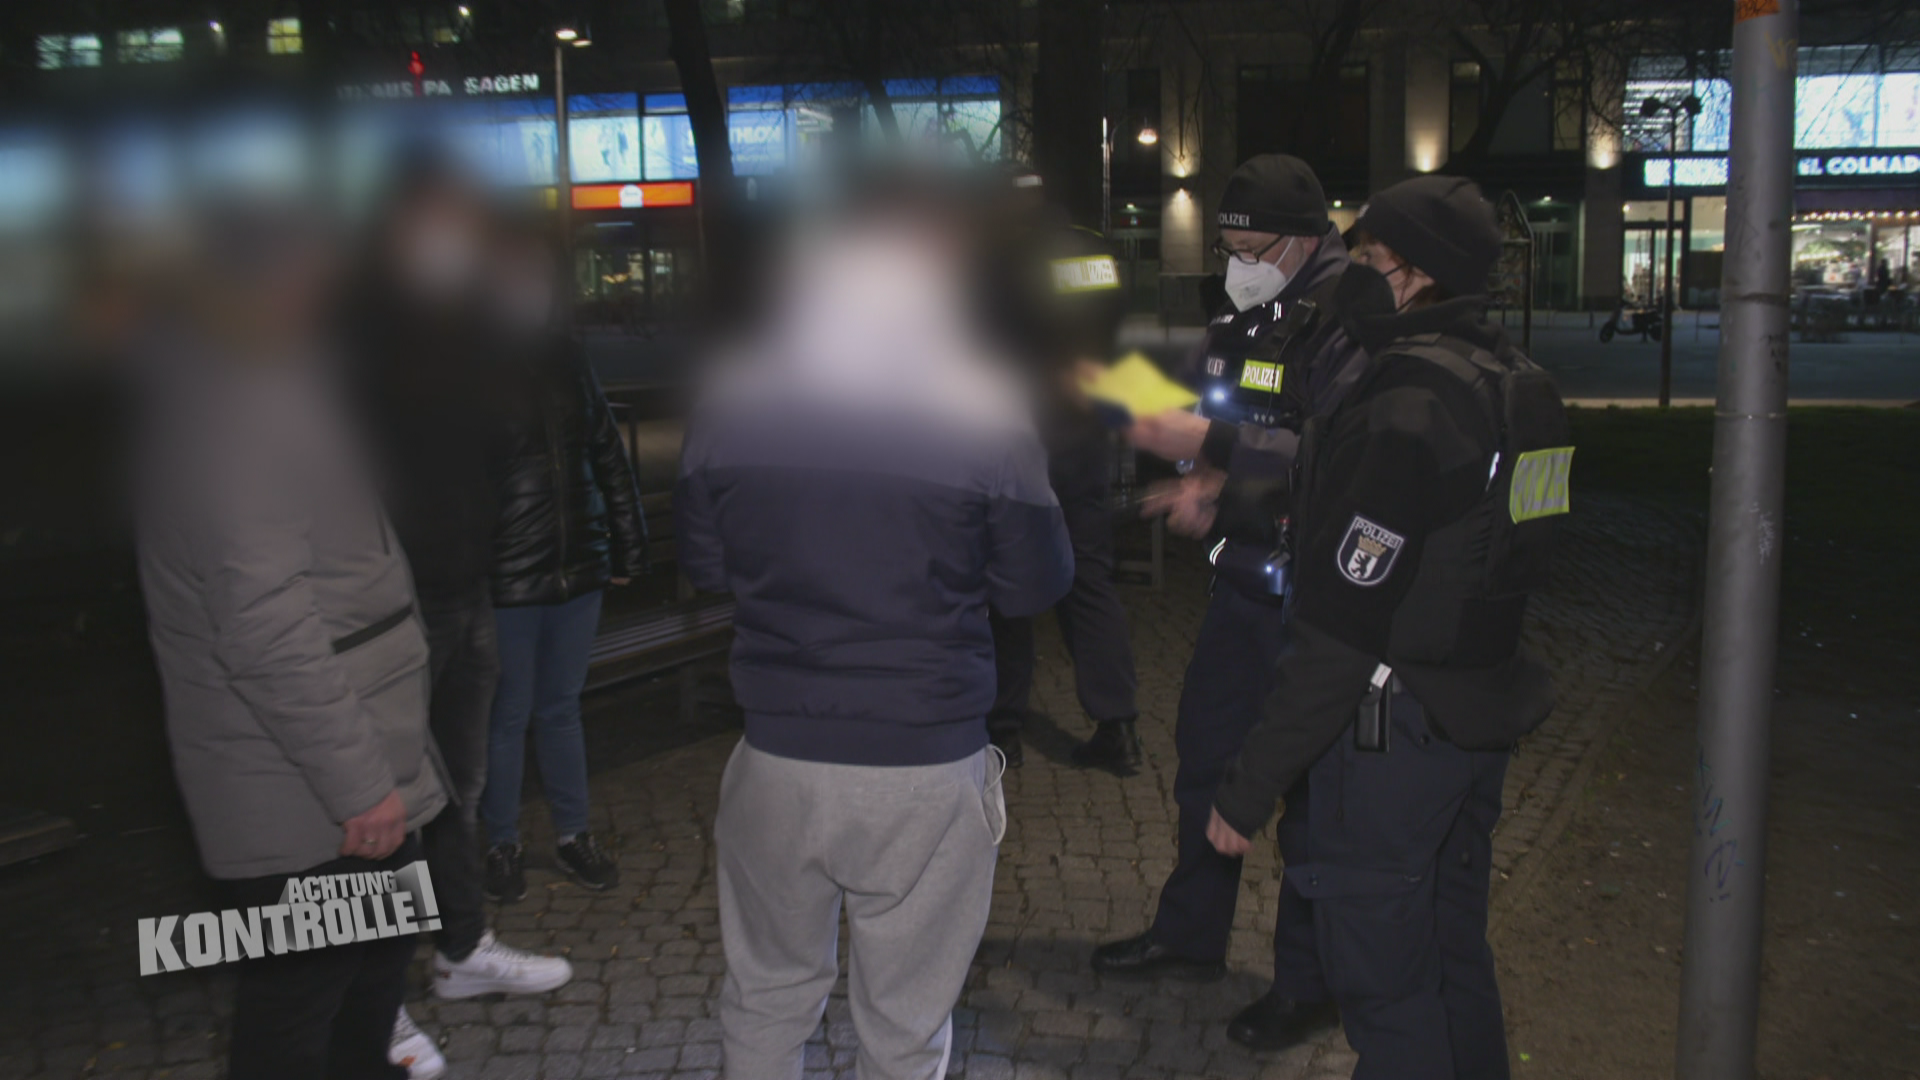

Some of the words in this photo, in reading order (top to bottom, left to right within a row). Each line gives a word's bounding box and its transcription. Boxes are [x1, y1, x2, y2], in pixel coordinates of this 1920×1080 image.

[1798, 157, 1824, 176] EL
[1826, 154, 1920, 176] COLMAD
[1218, 212, 1250, 227] OLIZEI
[1243, 365, 1280, 388] POLIZEI
[1354, 521, 1399, 548] POLIZEI
